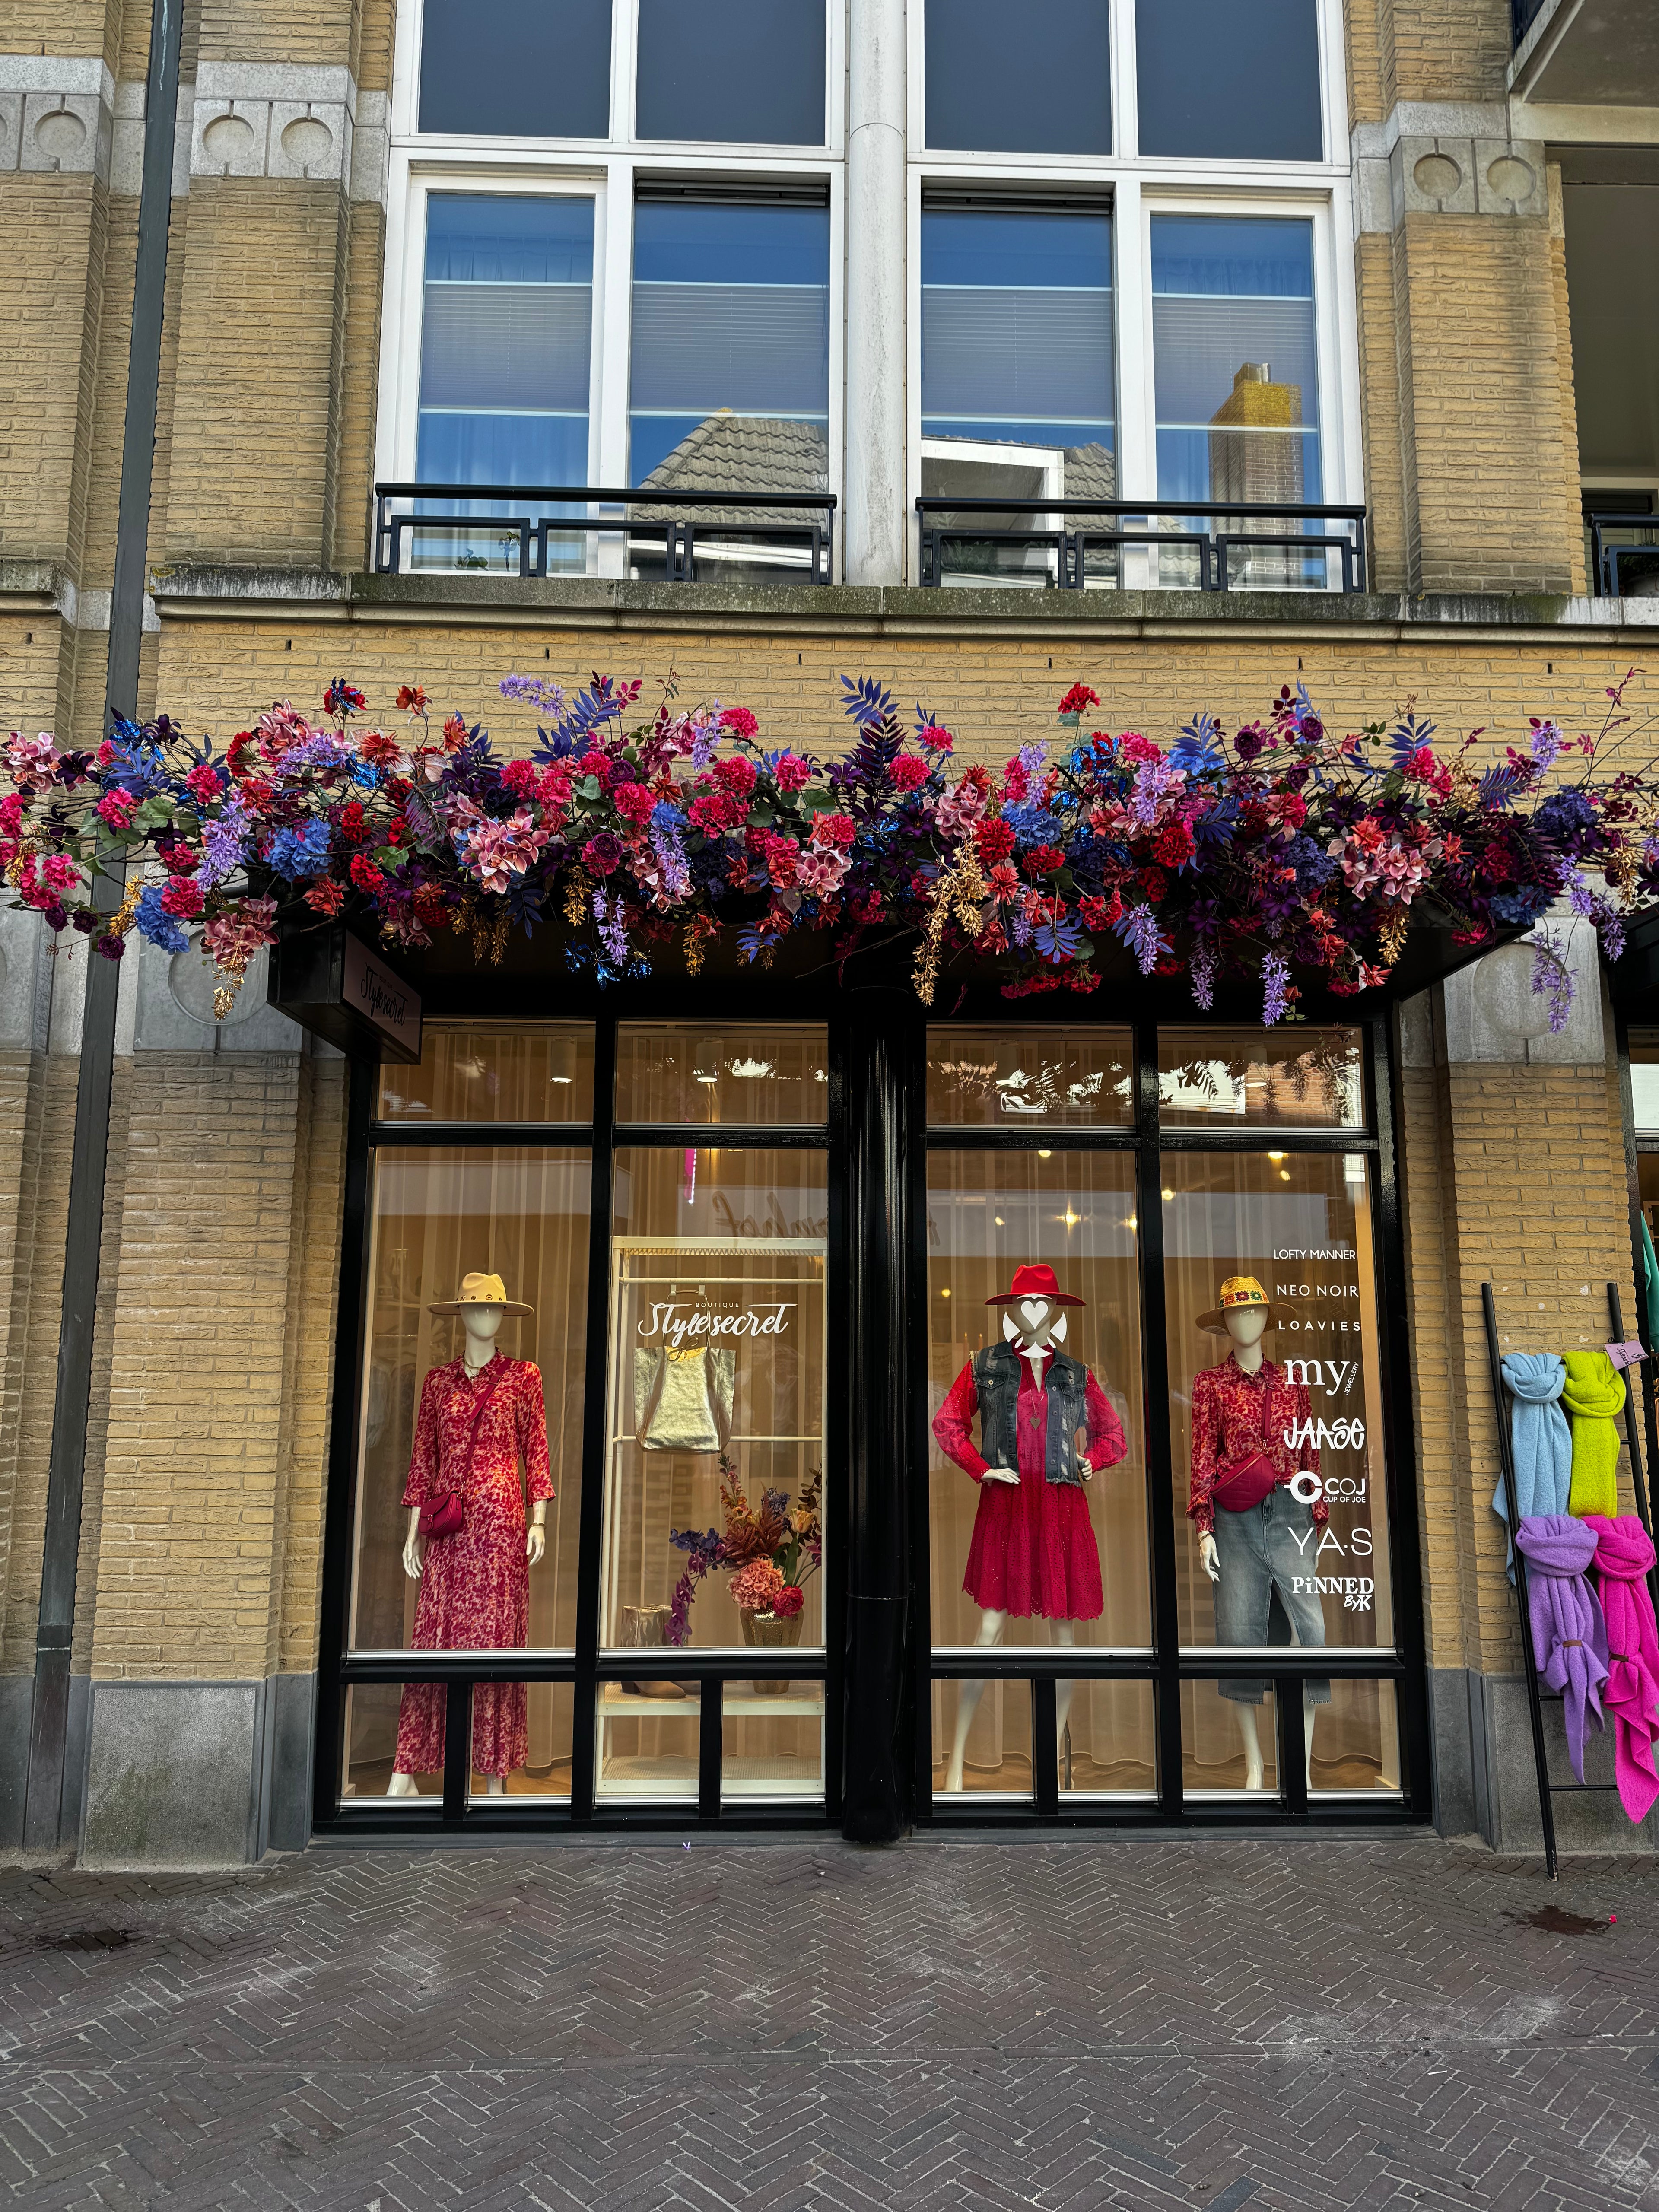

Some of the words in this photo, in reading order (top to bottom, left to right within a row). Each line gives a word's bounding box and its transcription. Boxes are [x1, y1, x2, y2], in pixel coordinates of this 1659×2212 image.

[1274, 1249, 1307, 1260] LOFTY
[1310, 1249, 1356, 1260] MANNER
[1277, 1284, 1310, 1297] NEO
[1317, 1285, 1359, 1297] NOIR
[637, 1302, 798, 1348] Stylesecret
[1278, 1320, 1361, 1332] LOAVIES
[1283, 1360, 1350, 1396] my
[1344, 1361, 1359, 1395] JEWELLERY
[1283, 1417, 1365, 1450] JAASE
[1325, 1478, 1366, 1495] COJ
